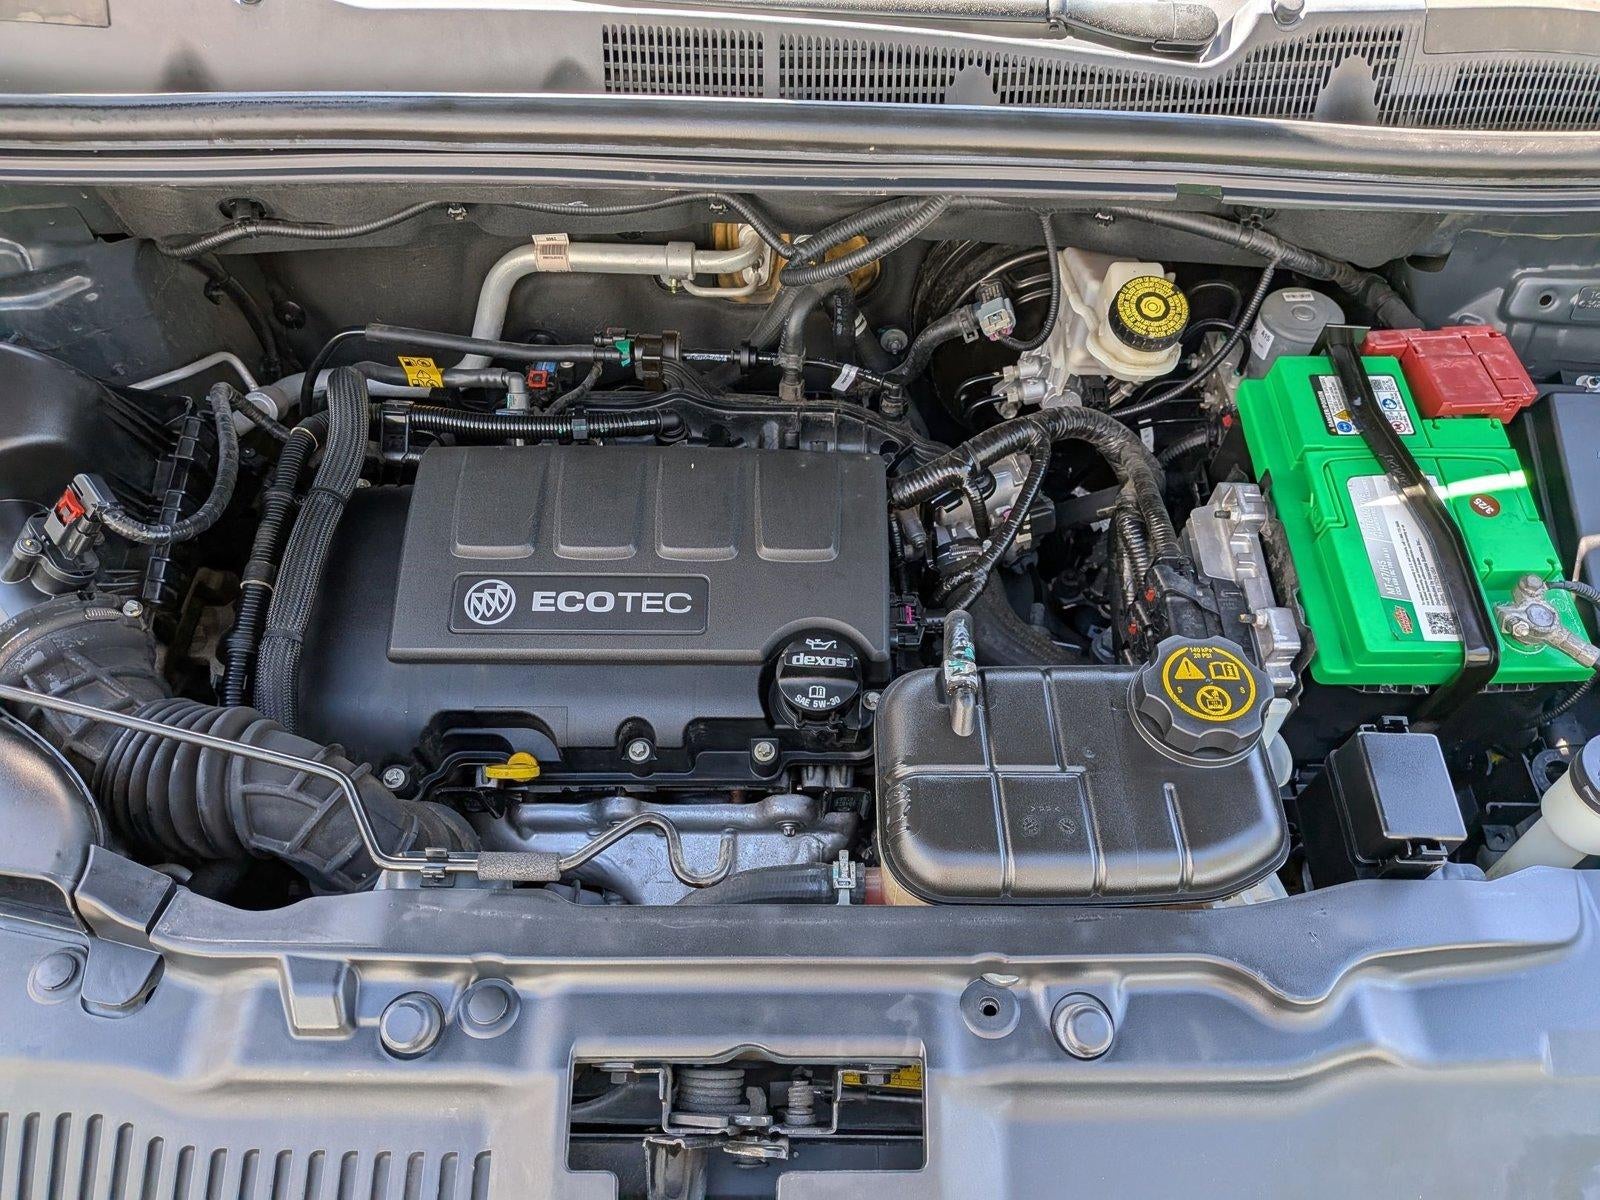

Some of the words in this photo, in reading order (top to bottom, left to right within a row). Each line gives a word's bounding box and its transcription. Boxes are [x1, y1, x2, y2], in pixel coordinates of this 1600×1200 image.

[1474, 498, 1494, 515] 3/25
[532, 591, 692, 614] ECOTEC
[792, 652, 847, 668] dexos
[795, 694, 810, 707] SAE
[813, 696, 840, 708] 5W-30
